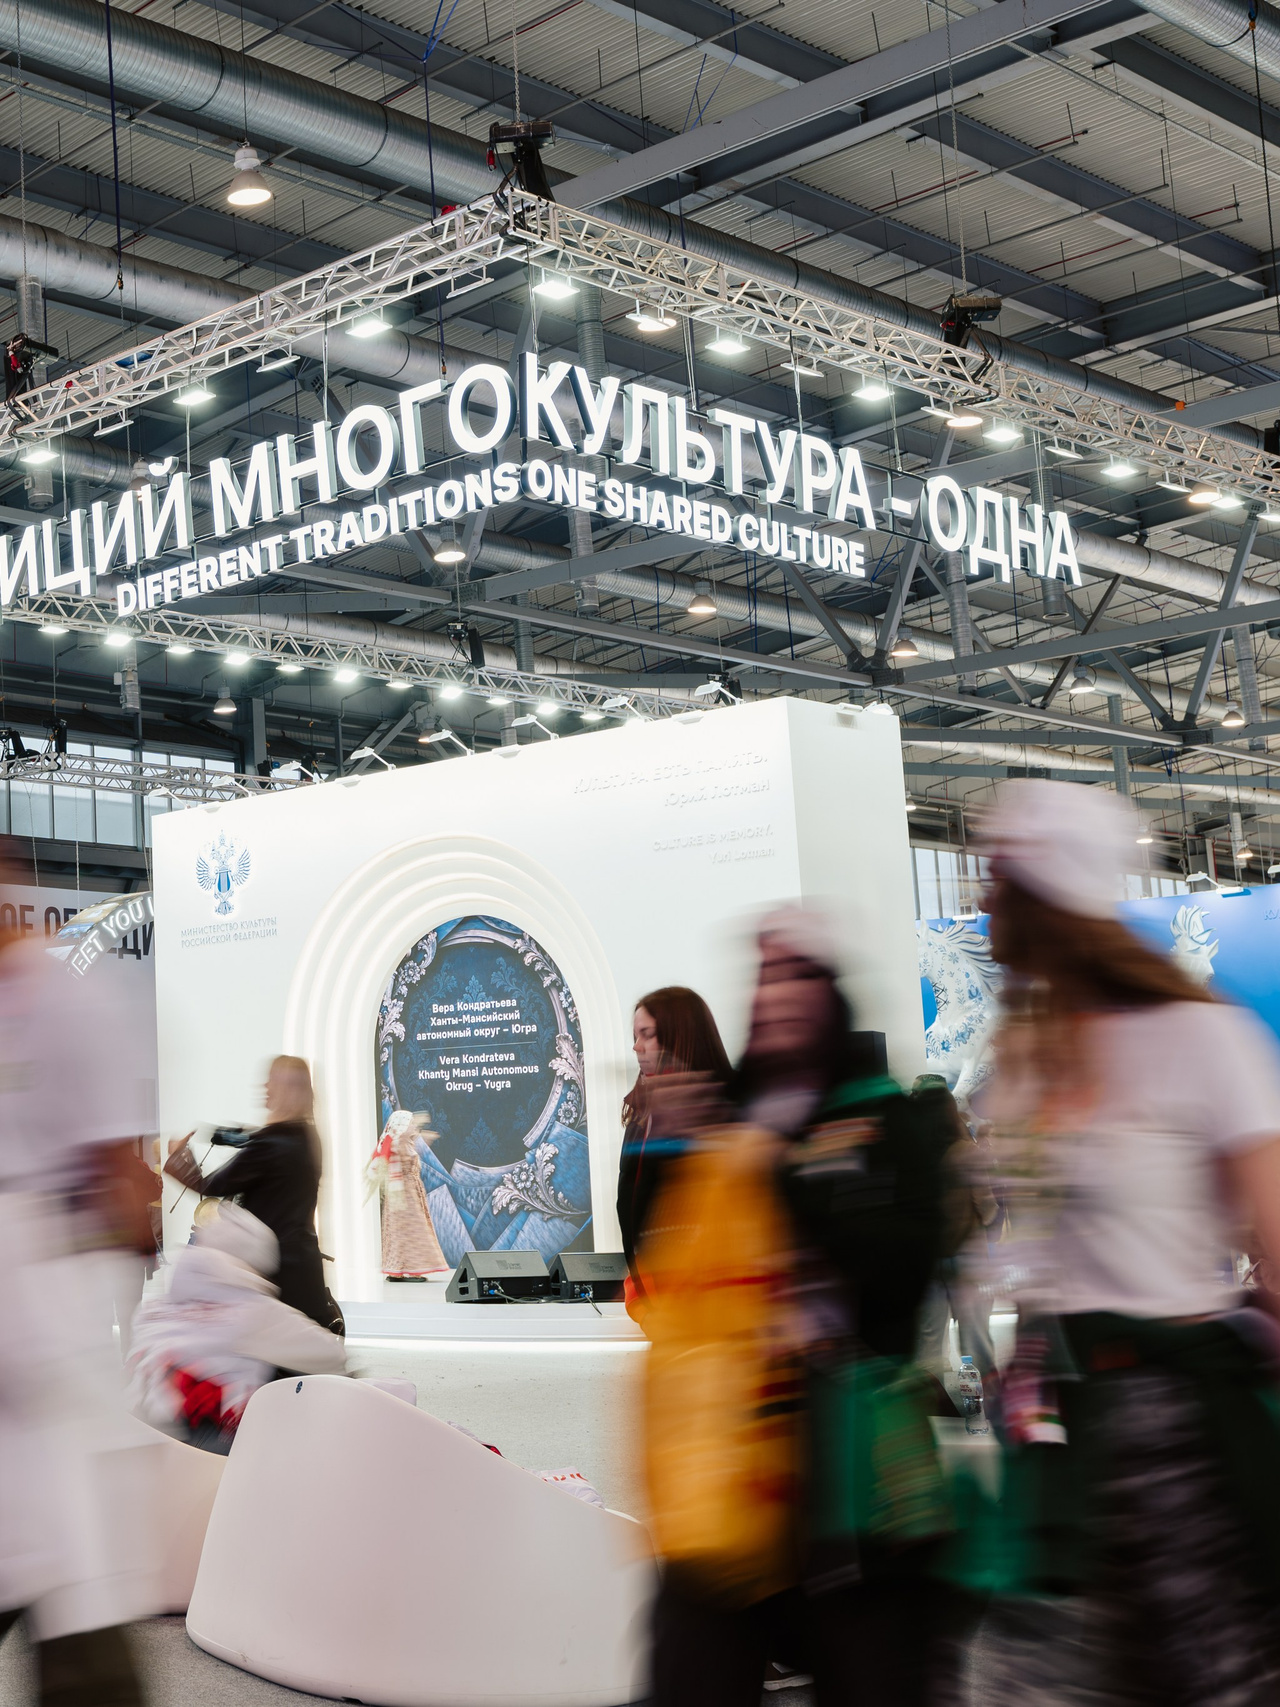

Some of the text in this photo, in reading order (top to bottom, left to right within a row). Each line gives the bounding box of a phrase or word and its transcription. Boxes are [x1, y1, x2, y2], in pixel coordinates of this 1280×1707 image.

[211, 362, 520, 536] МНОГО
[520, 350, 877, 529] КУЛЬТУРА
[925, 474, 1082, 586] ОДНА
[117, 460, 866, 618] DIFFERENT TRADITIONS ONE SHARED CULTURE
[653, 831, 703, 851] CULTURE
[719, 823, 773, 843] MEMORY.
[180, 916, 278, 938] МИНИСТЕРСТВО КУЛЬТУРЫ
[180, 928, 278, 949] РОССИЙСКОЙ ФЕДЕРАЦИИ
[432, 998, 517, 1014] Вера Кондратьева
[430, 1010, 520, 1026] Ханты-Мансийский
[416, 1026, 472, 1041] автономный
[474, 1027, 501, 1038] округ
[511, 1024, 537, 1036] Югра
[439, 1052, 515, 1065] Vera Kondrateva
[418, 1065, 539, 1082] Khanty Mansi Autonomous
[445, 1081, 474, 1093] Okrug
[484, 1079, 511, 1091] Yugra
